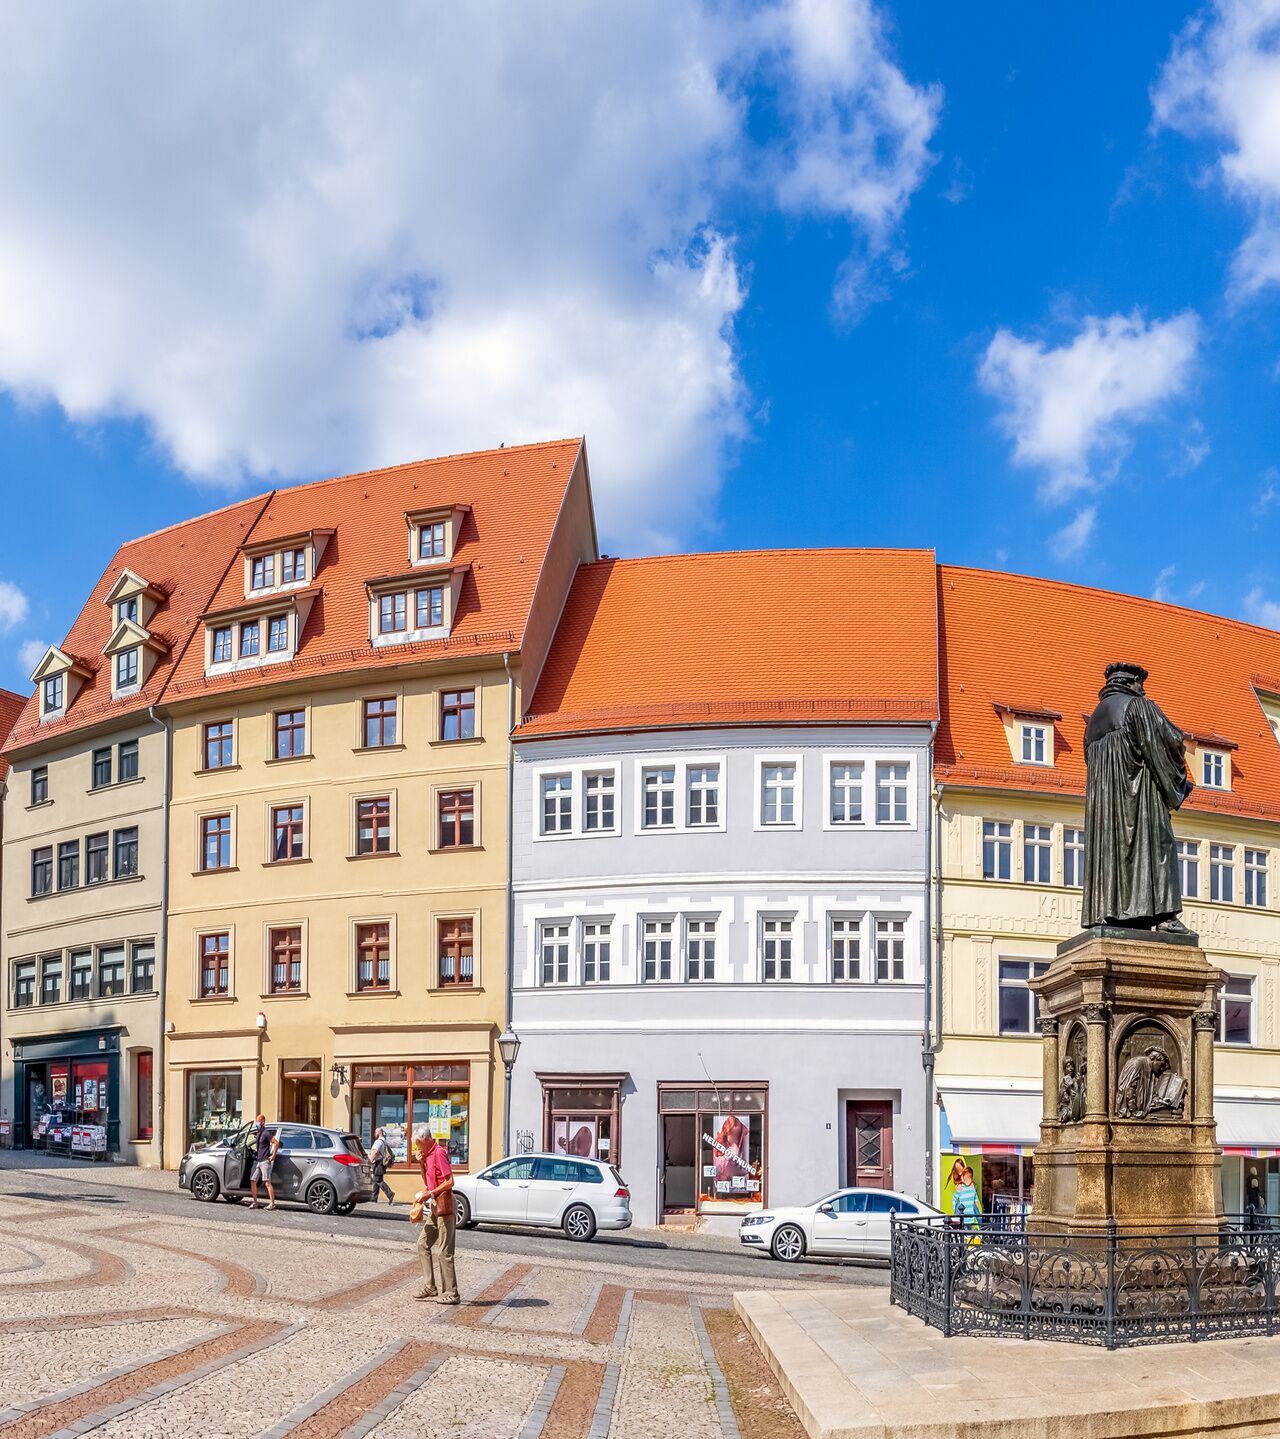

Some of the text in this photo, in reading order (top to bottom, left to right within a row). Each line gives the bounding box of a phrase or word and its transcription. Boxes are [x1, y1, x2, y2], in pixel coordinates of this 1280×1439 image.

[1037, 895, 1231, 934] KAUF ARKT
[702, 1133, 757, 1175] NEUERÖFFNUNG
